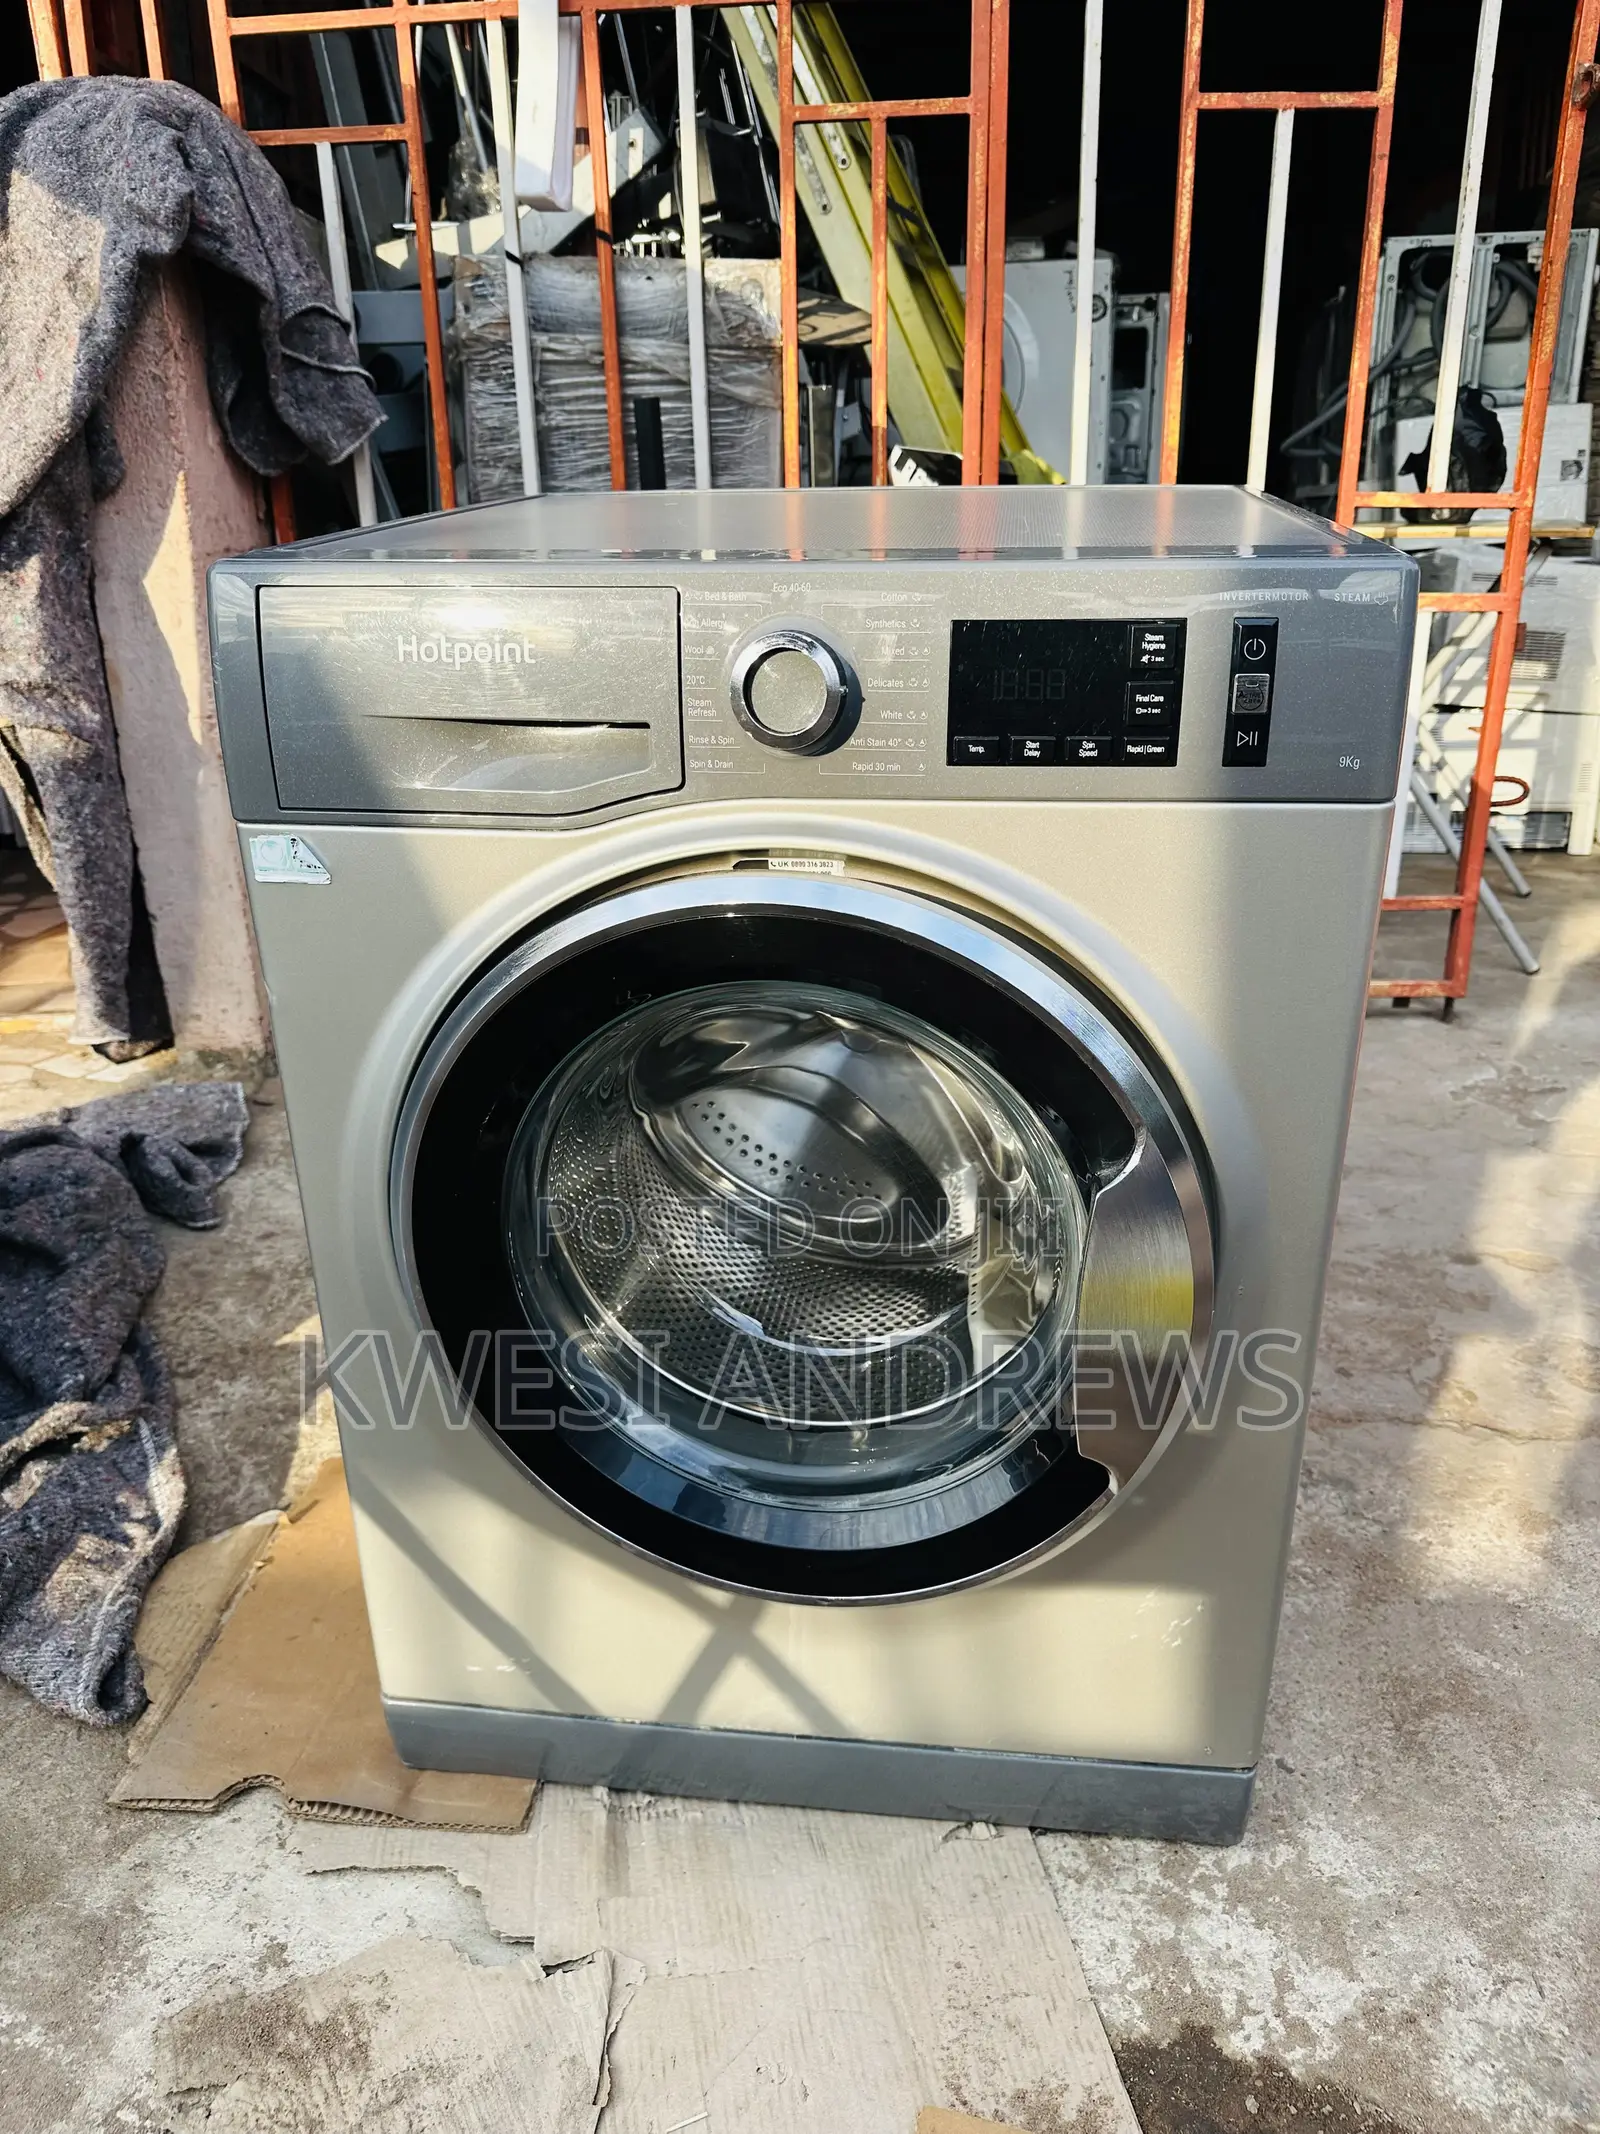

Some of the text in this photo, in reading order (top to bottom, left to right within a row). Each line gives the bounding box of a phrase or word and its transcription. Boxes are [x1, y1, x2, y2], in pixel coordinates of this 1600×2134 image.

[773, 582, 811, 592] Eco 40-60
[704, 591, 720, 600] Bed
[722, 592, 727, 600] &
[881, 592, 908, 602] Cotton
[1334, 593, 1370, 602] STEAM
[865, 618, 906, 630] Synthetics
[1144, 633, 1164, 642] Steam
[684, 645, 704, 654] Wool
[1142, 642, 1166, 651] Hygiene
[398, 634, 536, 671] Hotpoint
[686, 676, 705, 684] 20°C
[868, 678, 904, 688] Delicates
[687, 698, 712, 706] Steam
[1136, 694, 1164, 702] Final Care
[688, 708, 716, 717] Refresh
[880, 710, 902, 720] White
[688, 736, 735, 746] Rinse & Spin
[850, 737, 865, 746] Anti
[867, 738, 886, 746] Stain
[1025, 741, 1040, 749] Start
[1082, 741, 1095, 750] Spin
[968, 744, 985, 754] Temp.
[1024, 749, 1041, 758] Delay
[1079, 749, 1098, 758] Speed
[690, 760, 734, 769] Spin & Drain
[852, 762, 900, 772] Rapid 30 min
[1339, 755, 1360, 770] 9Kg
